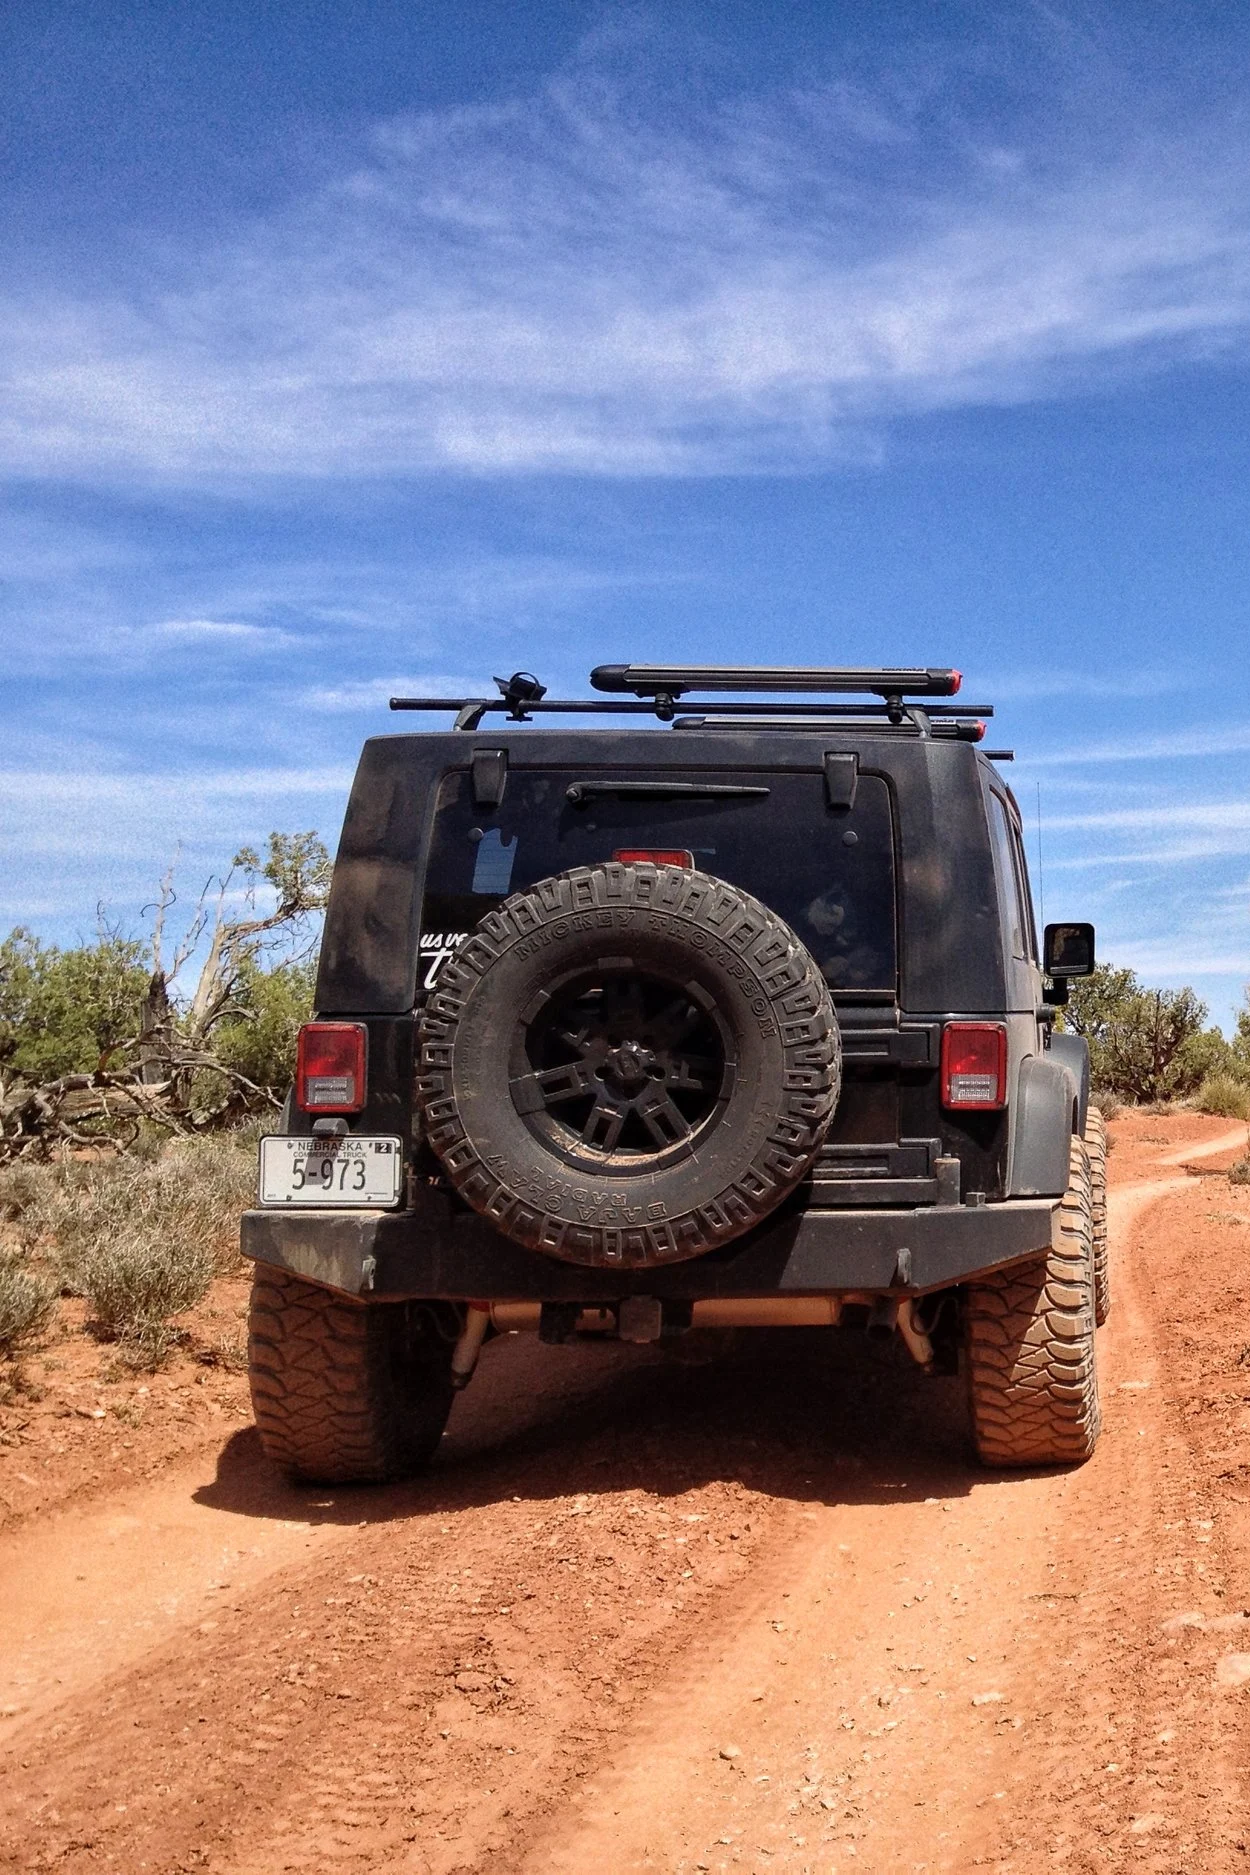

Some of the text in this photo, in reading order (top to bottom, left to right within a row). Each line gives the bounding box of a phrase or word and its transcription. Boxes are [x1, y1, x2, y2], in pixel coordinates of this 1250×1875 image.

[513, 908, 777, 1039] MICKEY THOMPSON
[292, 1151, 368, 1159] COMMERCIAL TRUCK
[297, 1141, 363, 1152] NEBRASKA
[292, 1158, 366, 1190] 5-973
[486, 1153, 668, 1225] BAJA CLAW
[530, 1165, 628, 1208] RADIAL
